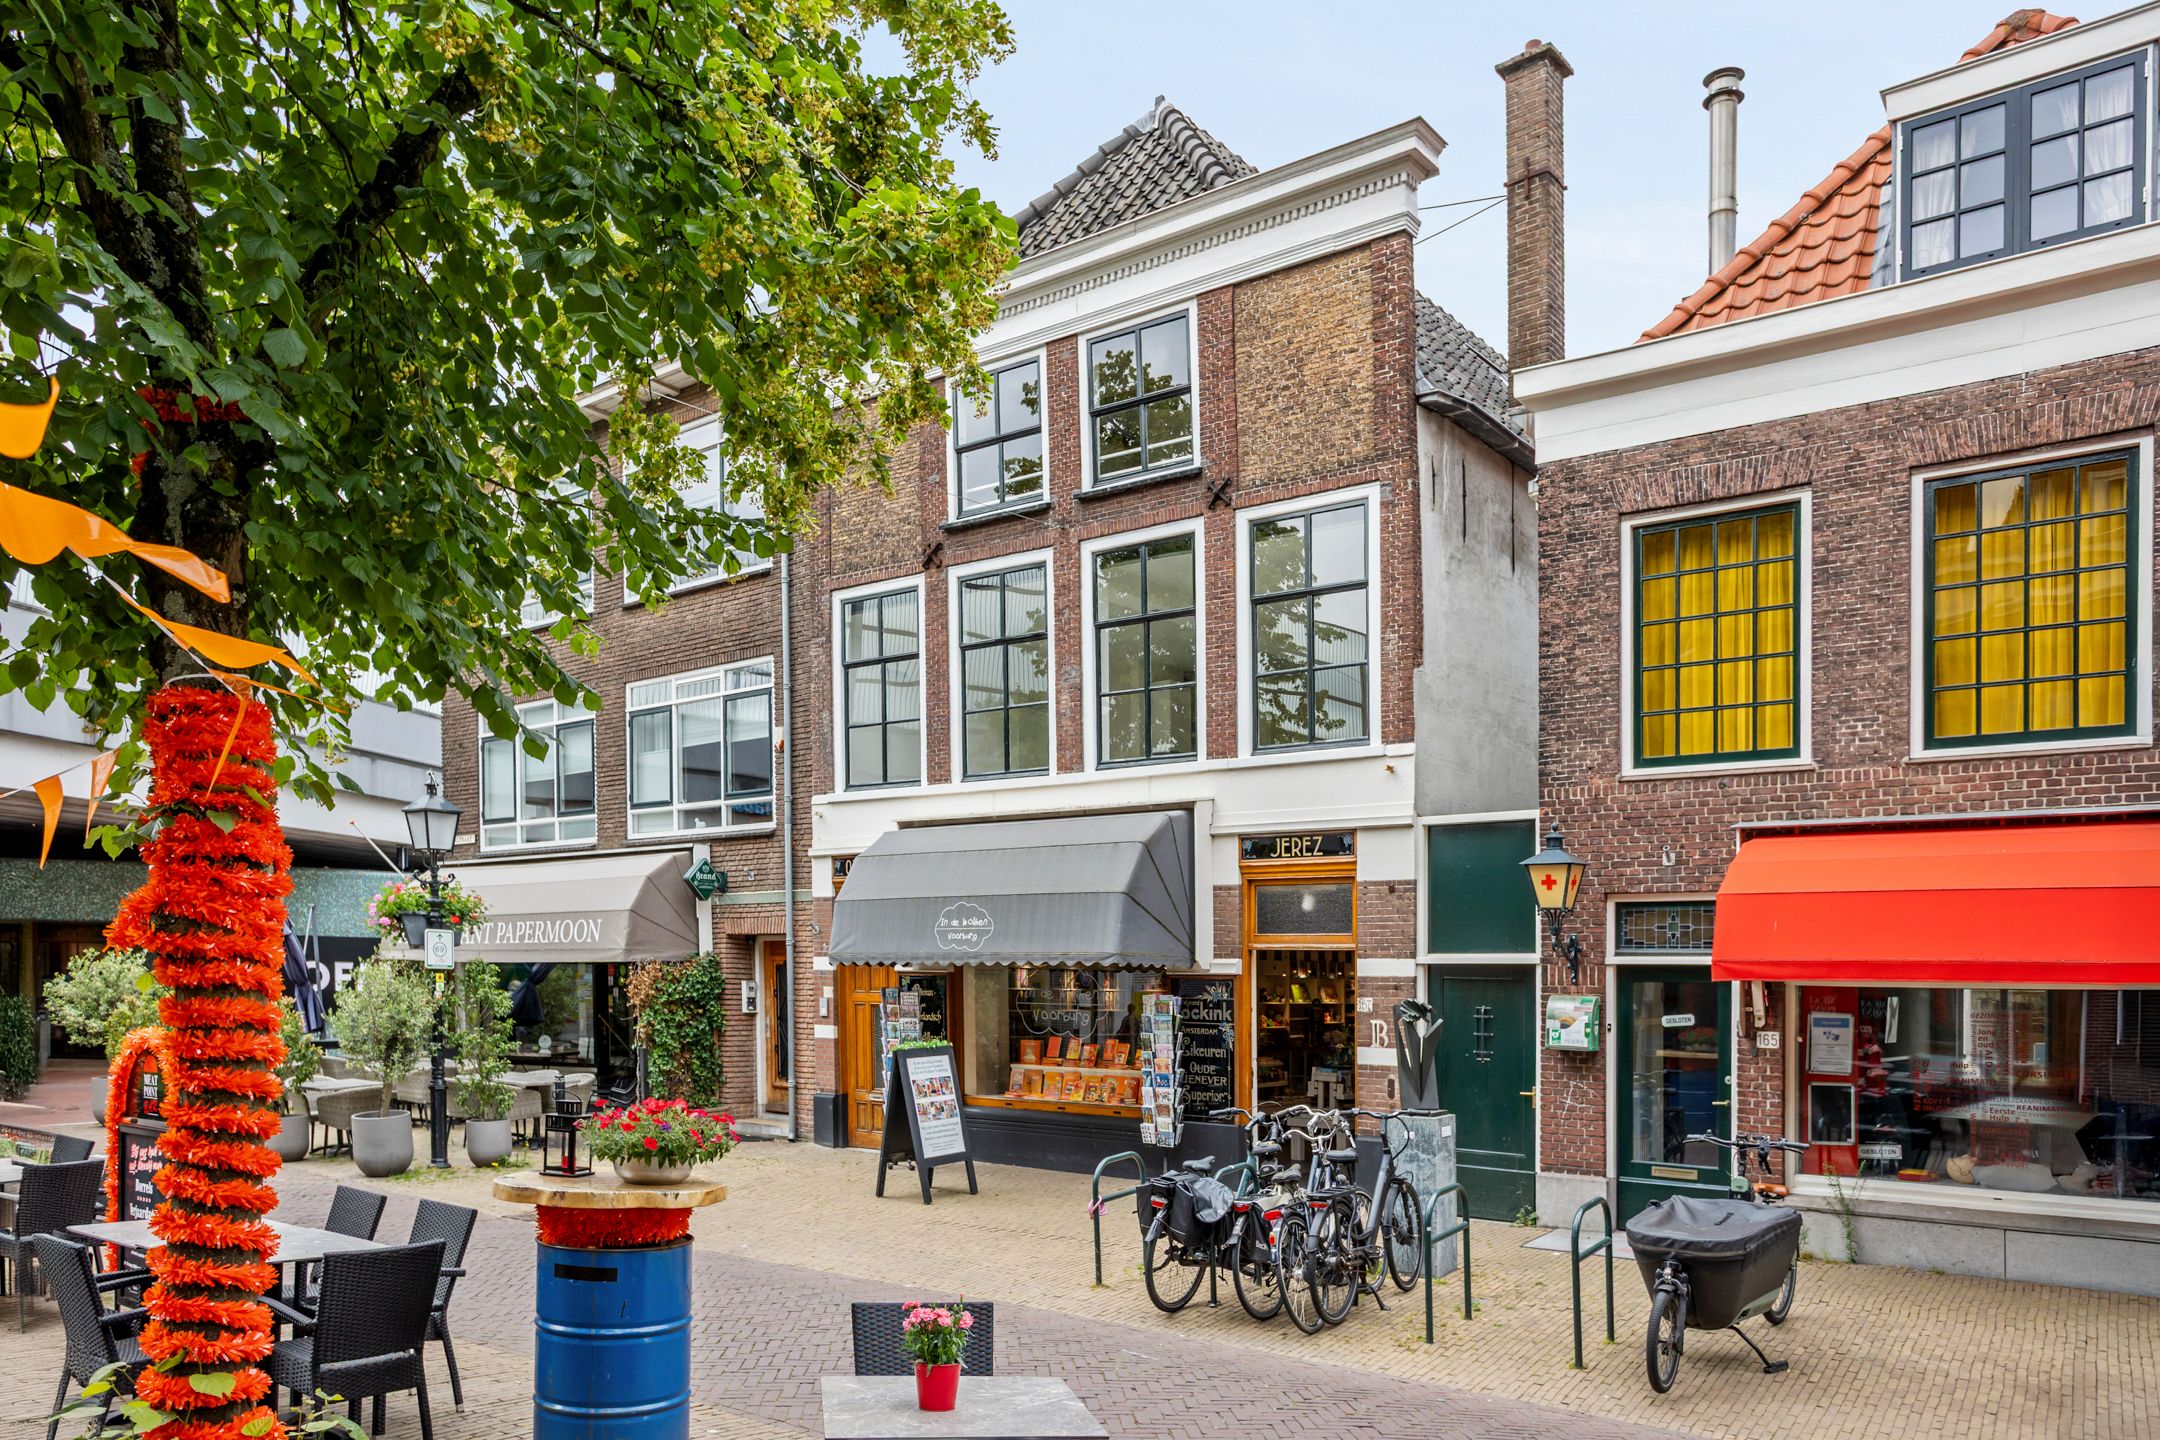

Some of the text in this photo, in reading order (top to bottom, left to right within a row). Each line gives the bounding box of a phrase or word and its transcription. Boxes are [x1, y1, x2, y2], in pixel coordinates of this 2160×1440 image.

[1270, 836, 1323, 857] JEREZ
[695, 870, 716, 880] Brand
[495, 919, 602, 943] PAPERMOON
[947, 932, 978, 942] Voorburg
[1033, 1008, 1090, 1026] Voorburg
[1181, 1002, 1232, 1021] ockink
[1181, 1025, 1218, 1036] AMSTERDAM
[1757, 1034, 1778, 1046] 165
[1985, 1050, 1993, 1068] AED
[1190, 1061, 1217, 1075] OUDE
[1989, 1107, 2016, 1115] Eerste
[2016, 1104, 2066, 1112] REANIMATI
[1989, 1114, 2010, 1122] Hulp
[135, 1178, 153, 1194] Borrels
